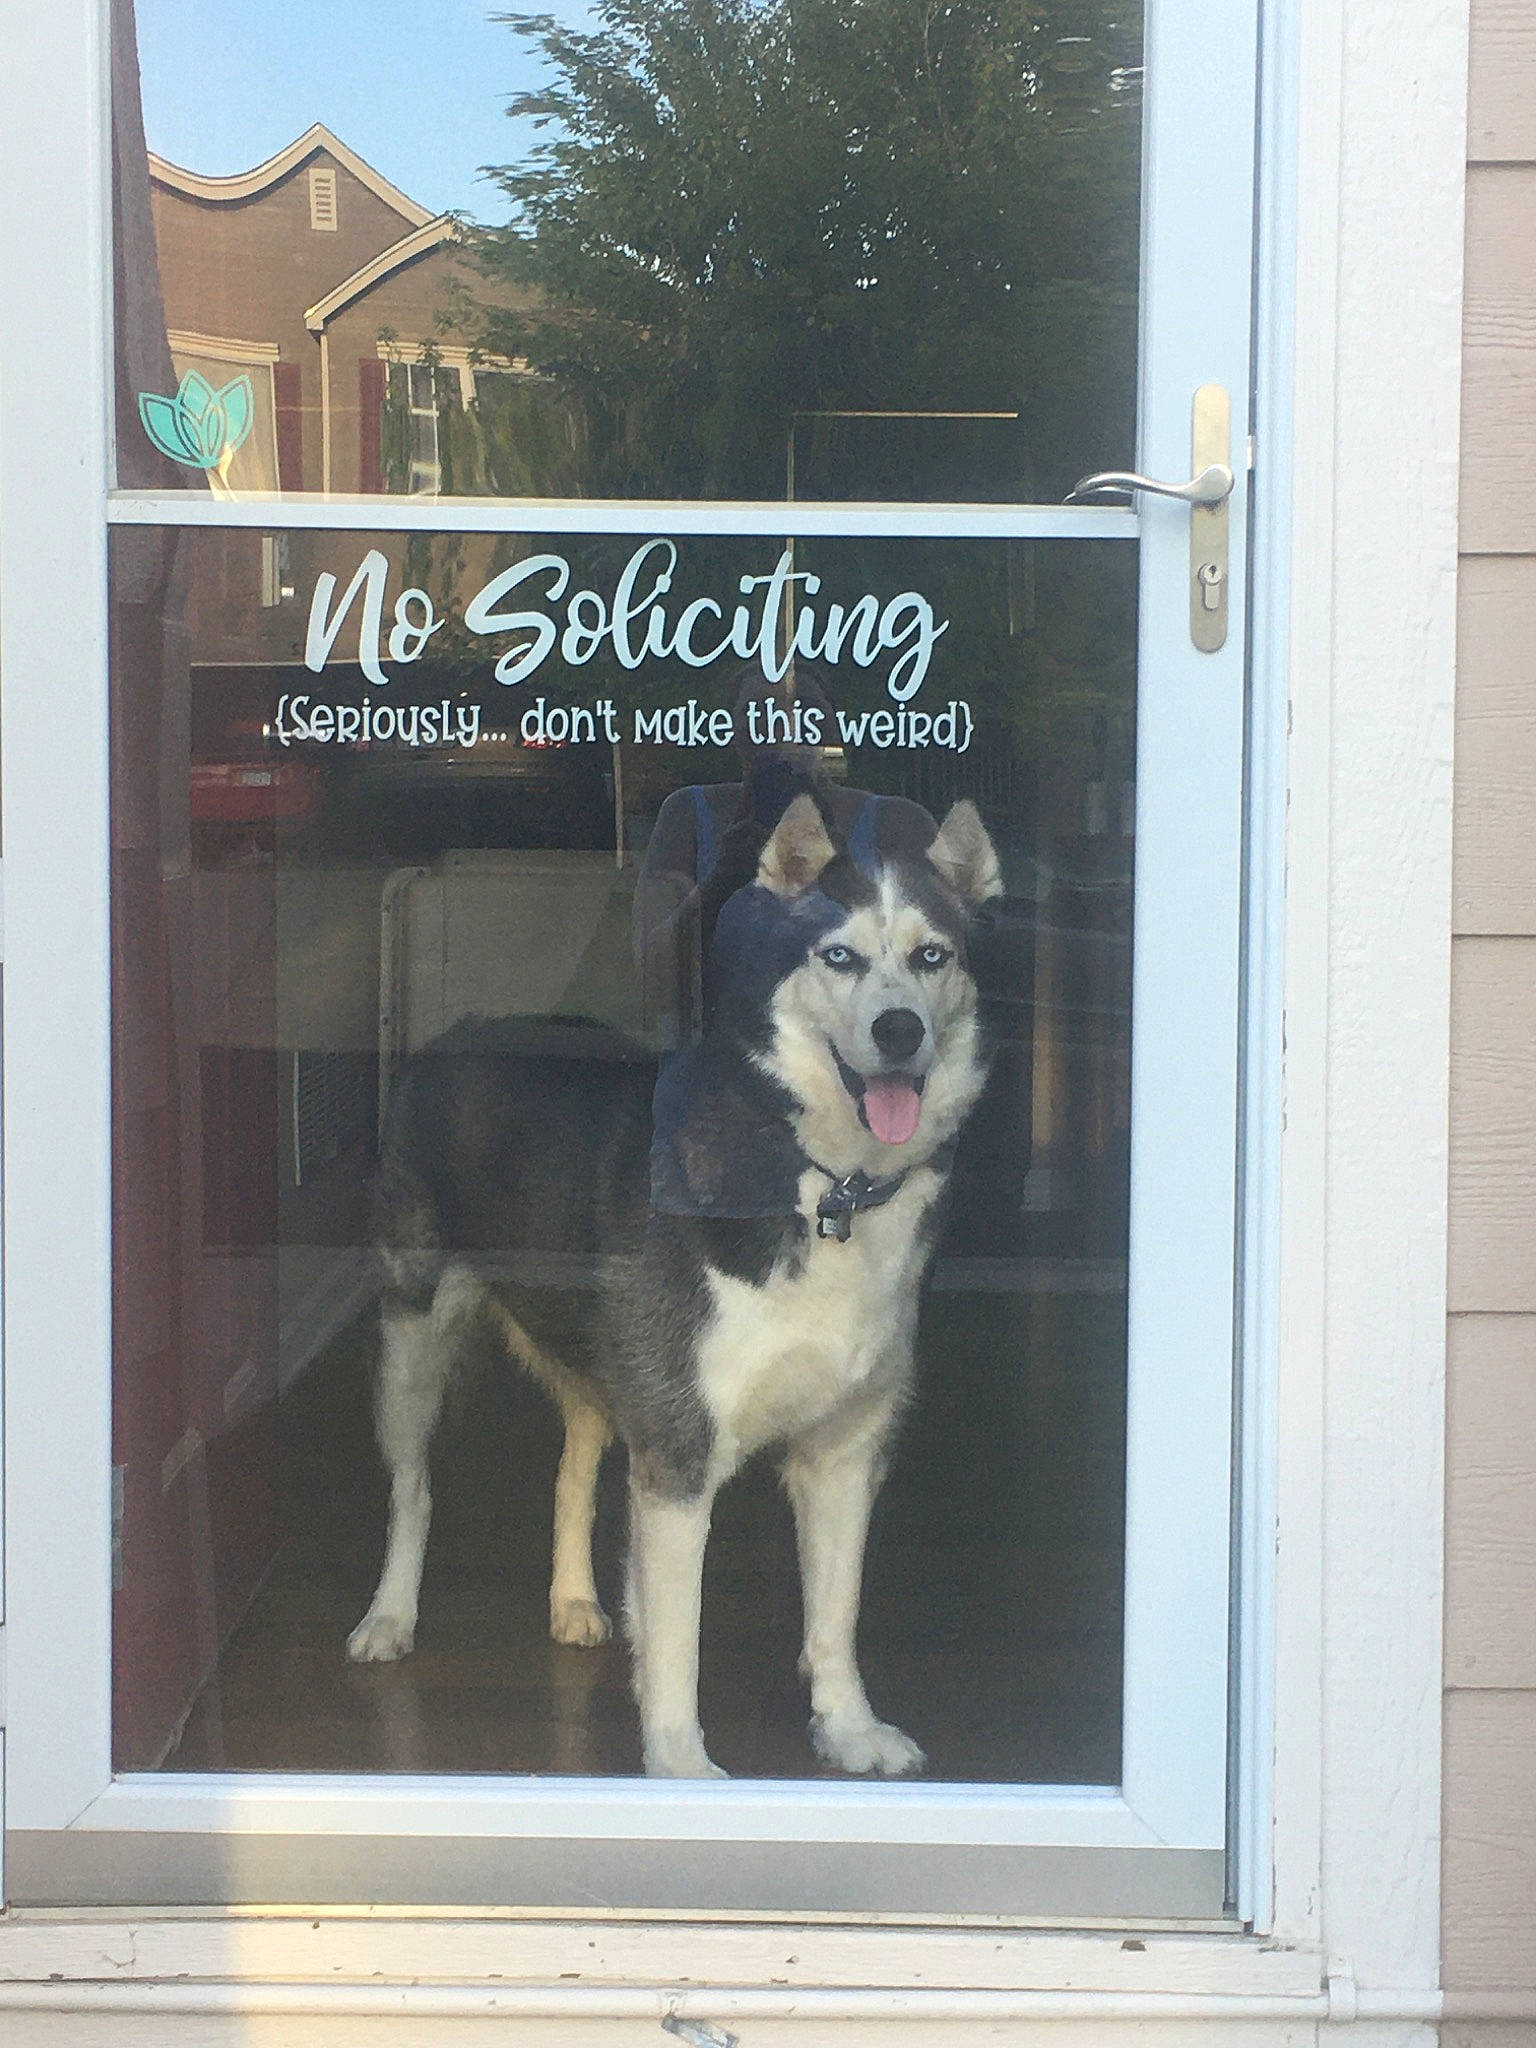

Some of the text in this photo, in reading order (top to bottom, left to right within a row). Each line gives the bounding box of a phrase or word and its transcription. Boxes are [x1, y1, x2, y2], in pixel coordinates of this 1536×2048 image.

[304, 537, 950, 702] No Soliciting
[520, 697, 622, 745] don't
[746, 697, 826, 745] this
